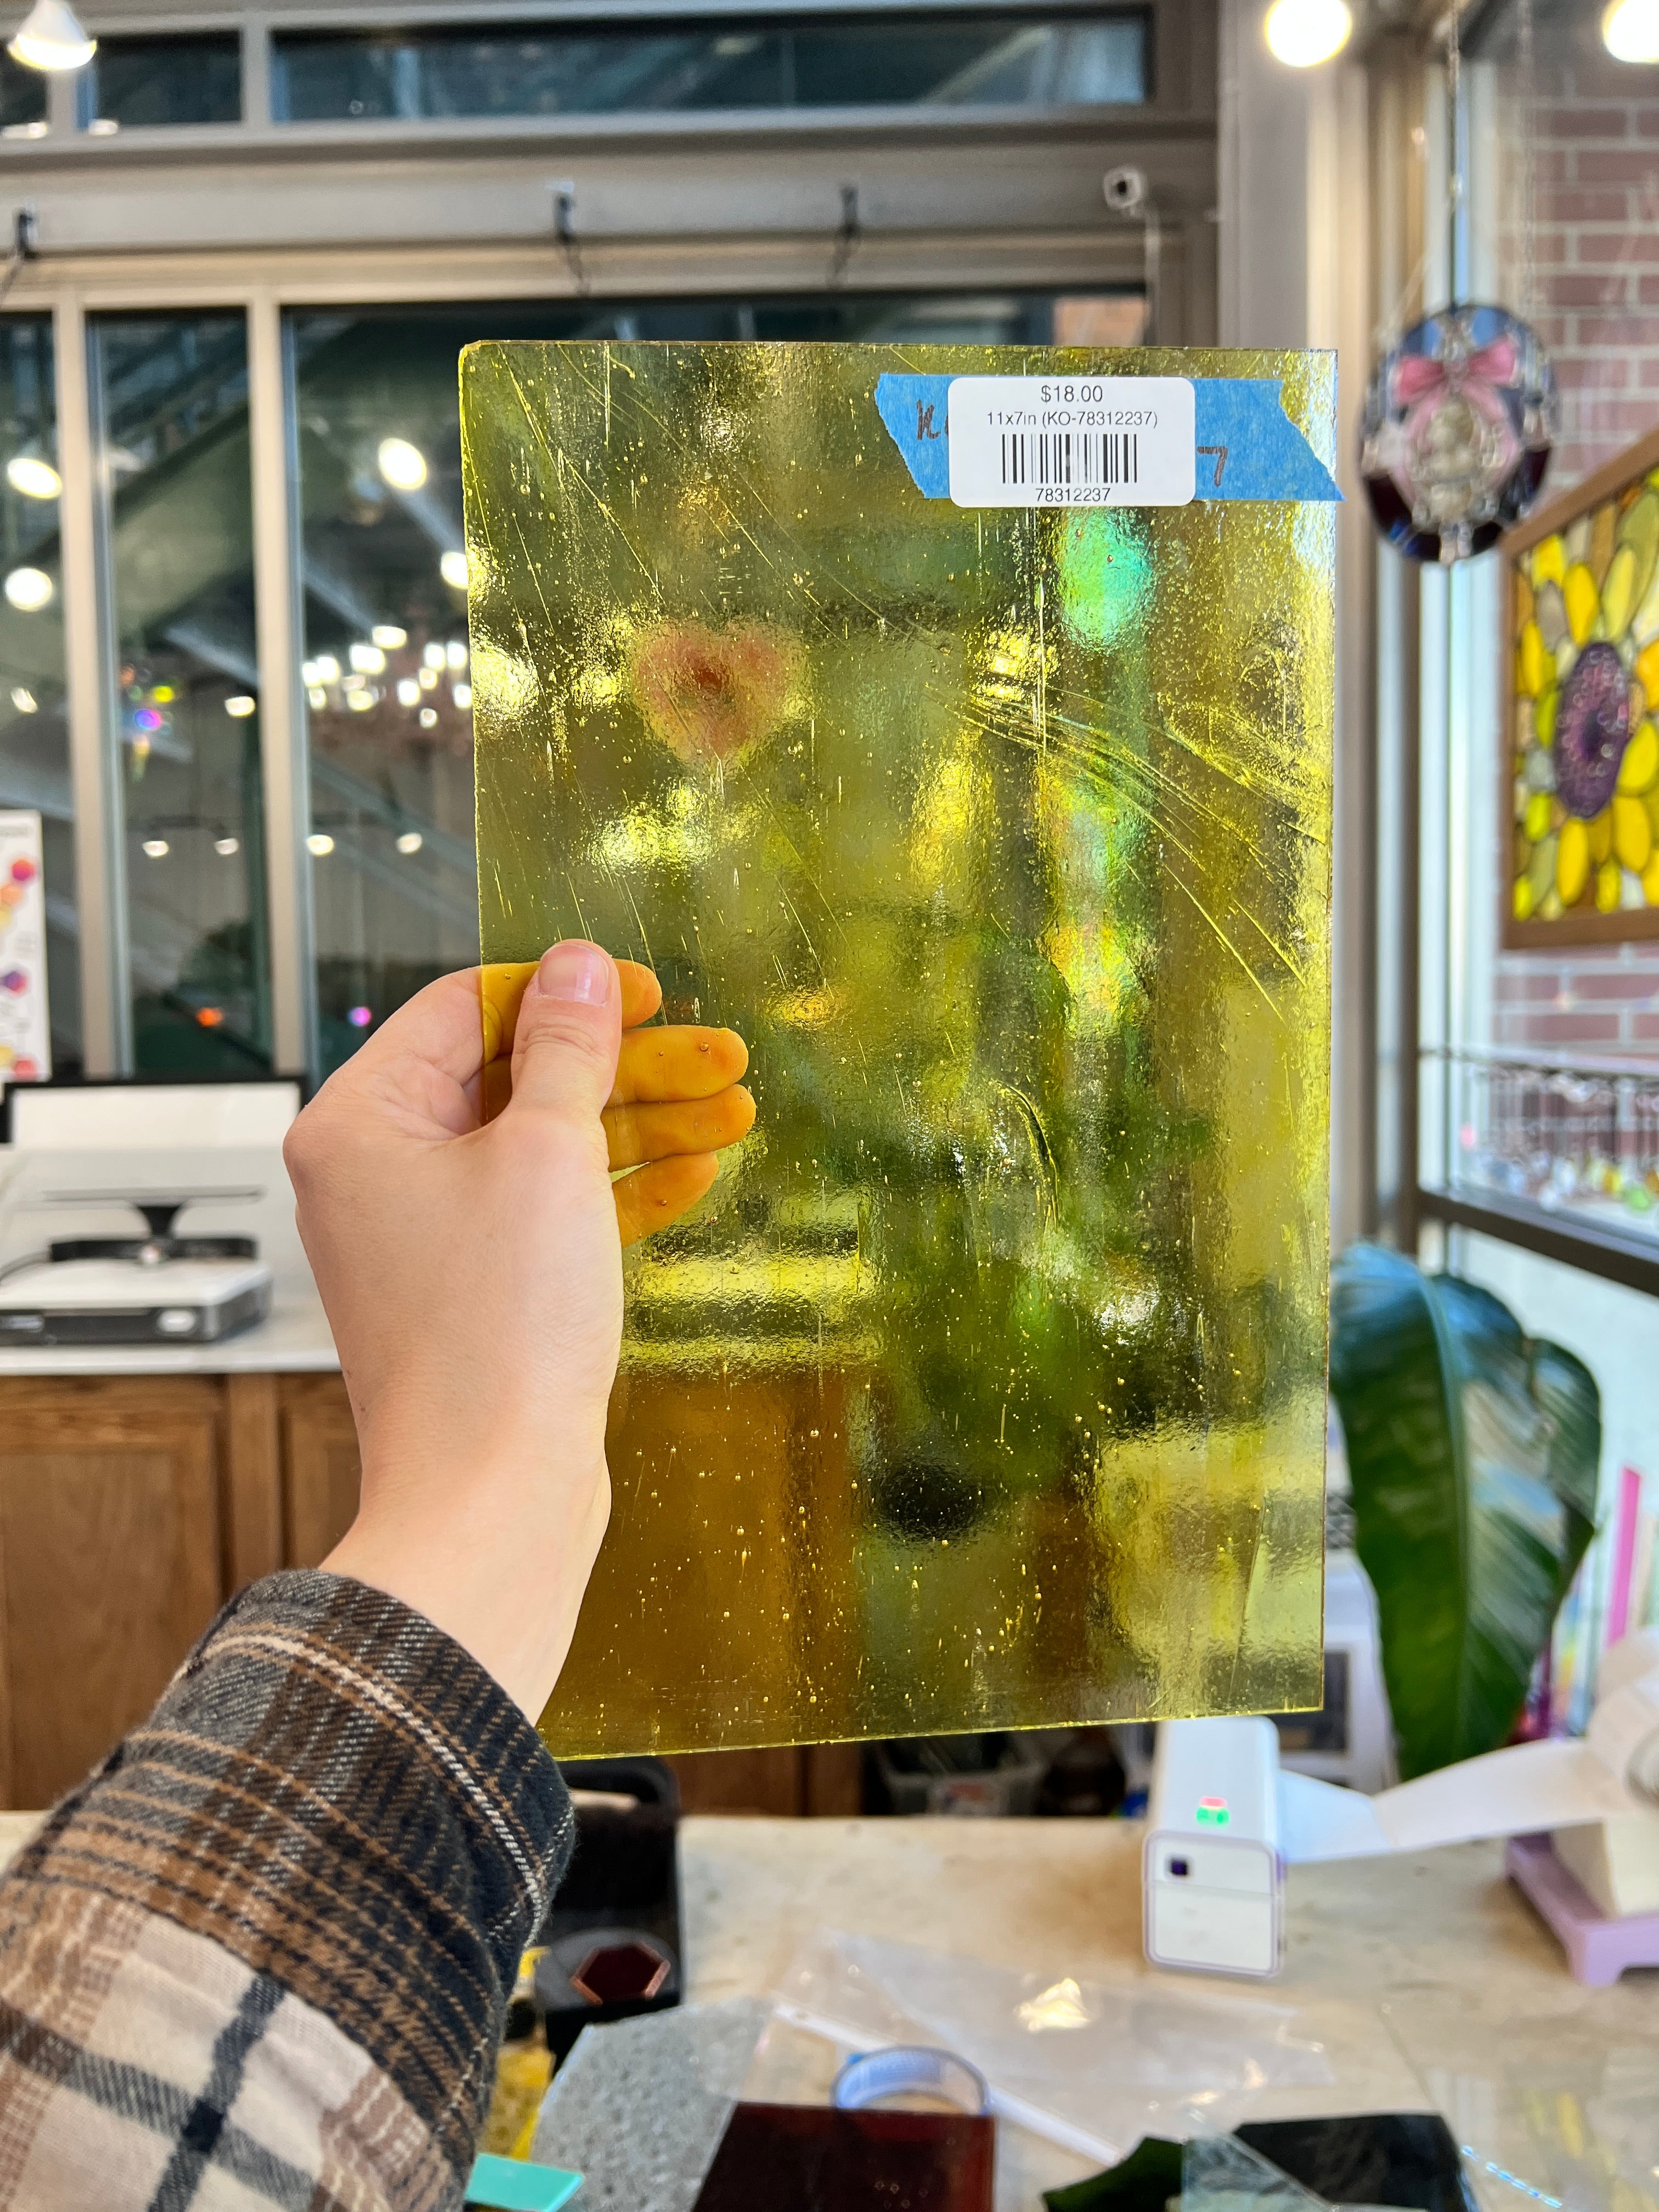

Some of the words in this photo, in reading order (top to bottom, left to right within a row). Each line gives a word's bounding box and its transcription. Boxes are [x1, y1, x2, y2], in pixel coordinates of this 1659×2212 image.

[1041, 385, 1103, 403] $18.00
[916, 398, 949, 441] K
[987, 411, 1037, 426] 11x7in
[1042, 411, 1158, 429] (KO-78312237)
[1035, 487, 1111, 503] 78312237
